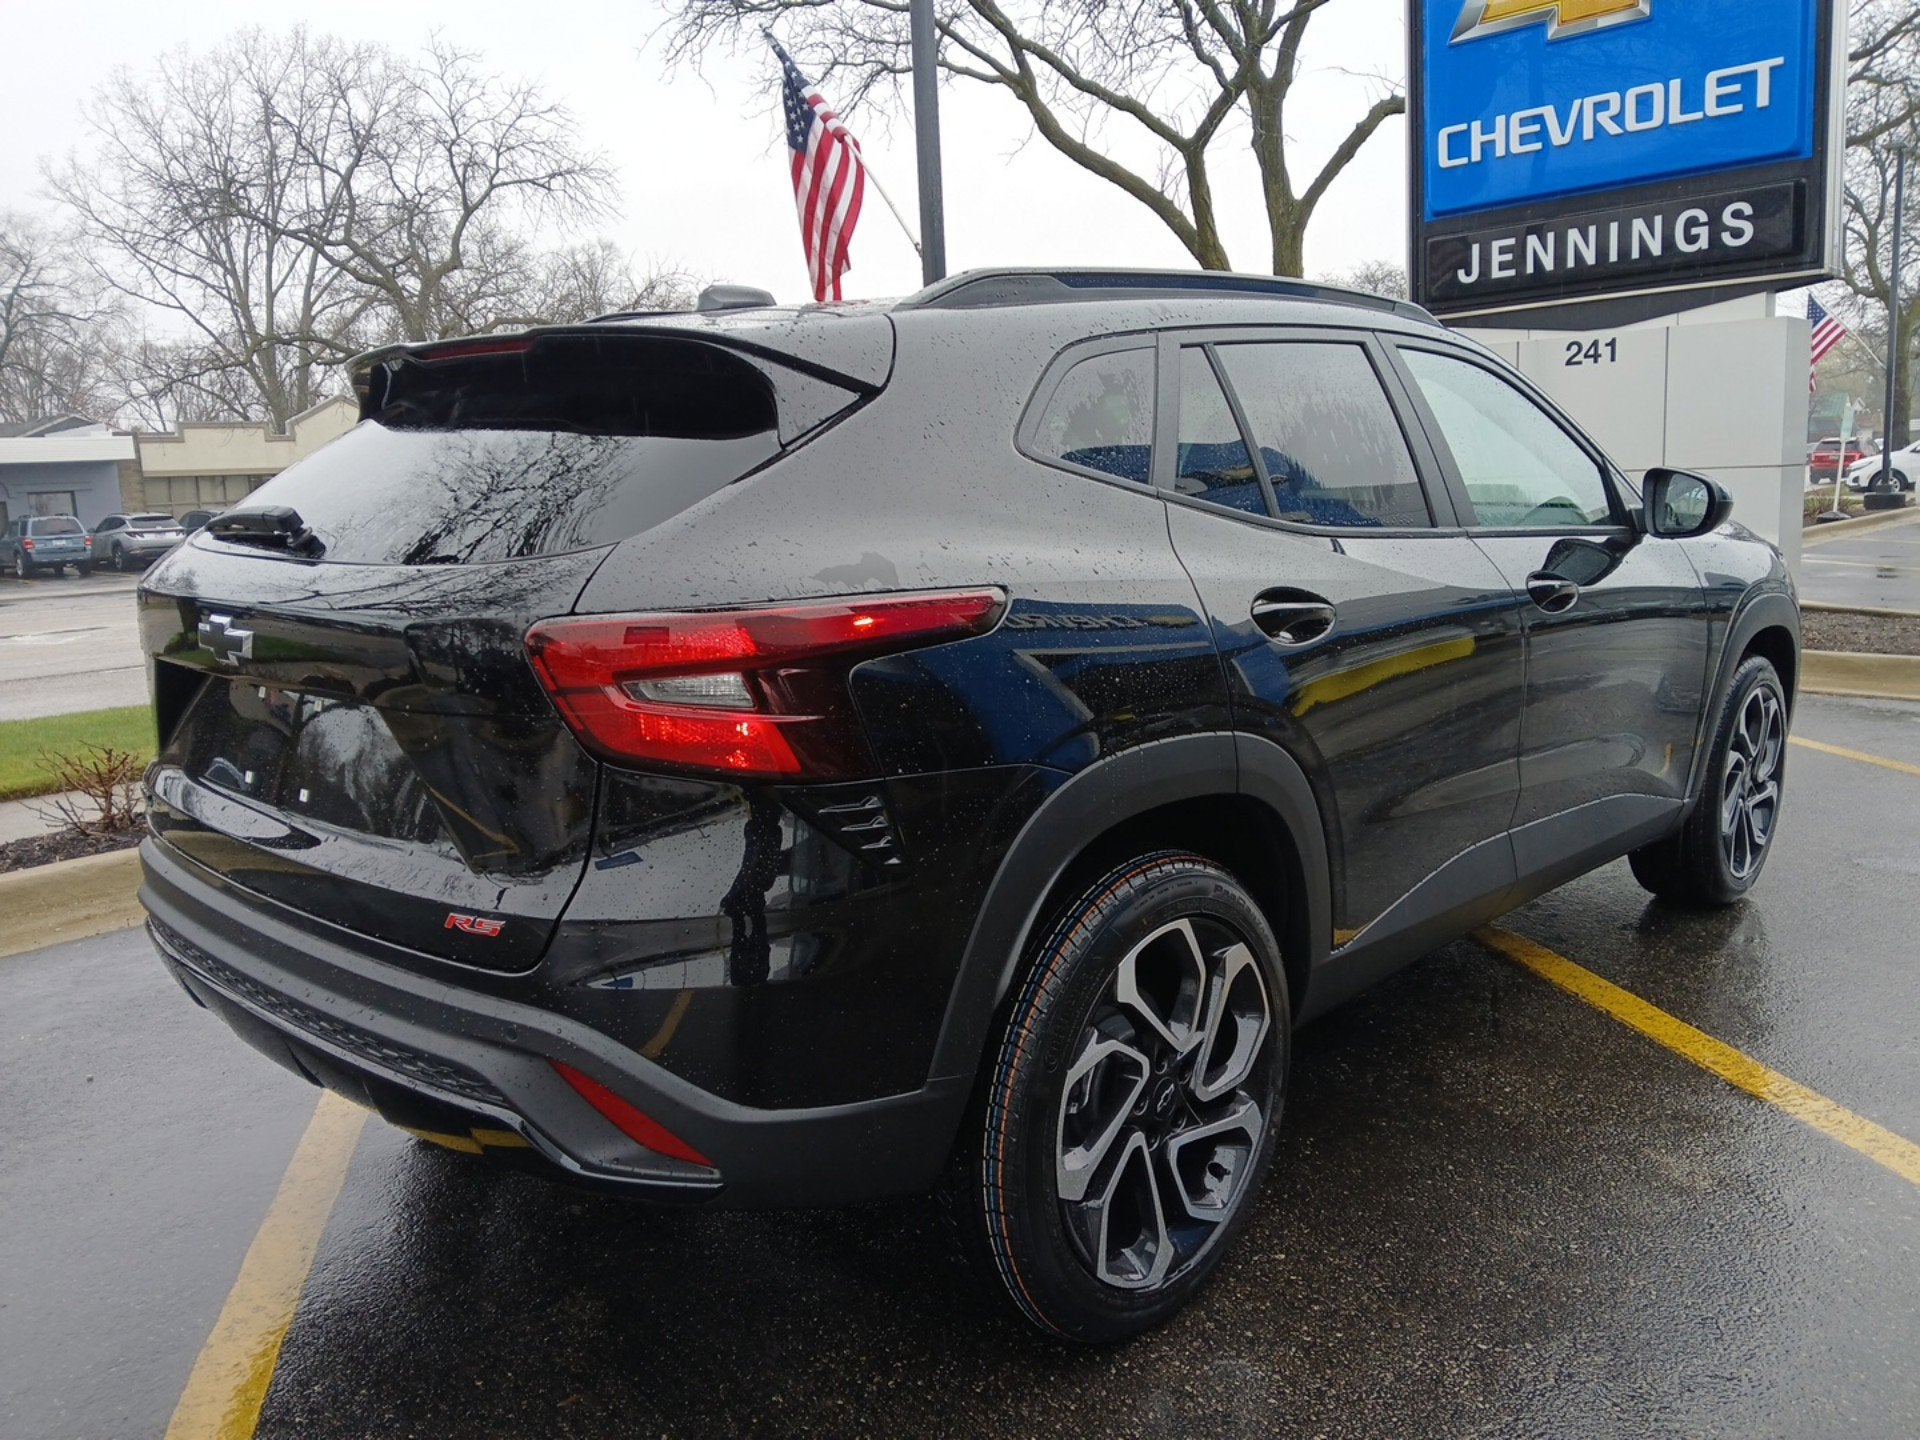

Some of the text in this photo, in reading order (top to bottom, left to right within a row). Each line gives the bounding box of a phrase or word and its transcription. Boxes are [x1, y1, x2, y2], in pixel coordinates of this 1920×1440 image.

[1438, 57, 1784, 168] CHEVROLET
[1457, 201, 1754, 284] JENNINGS
[1565, 337, 1618, 366] 241
[444, 912, 506, 937] RS
